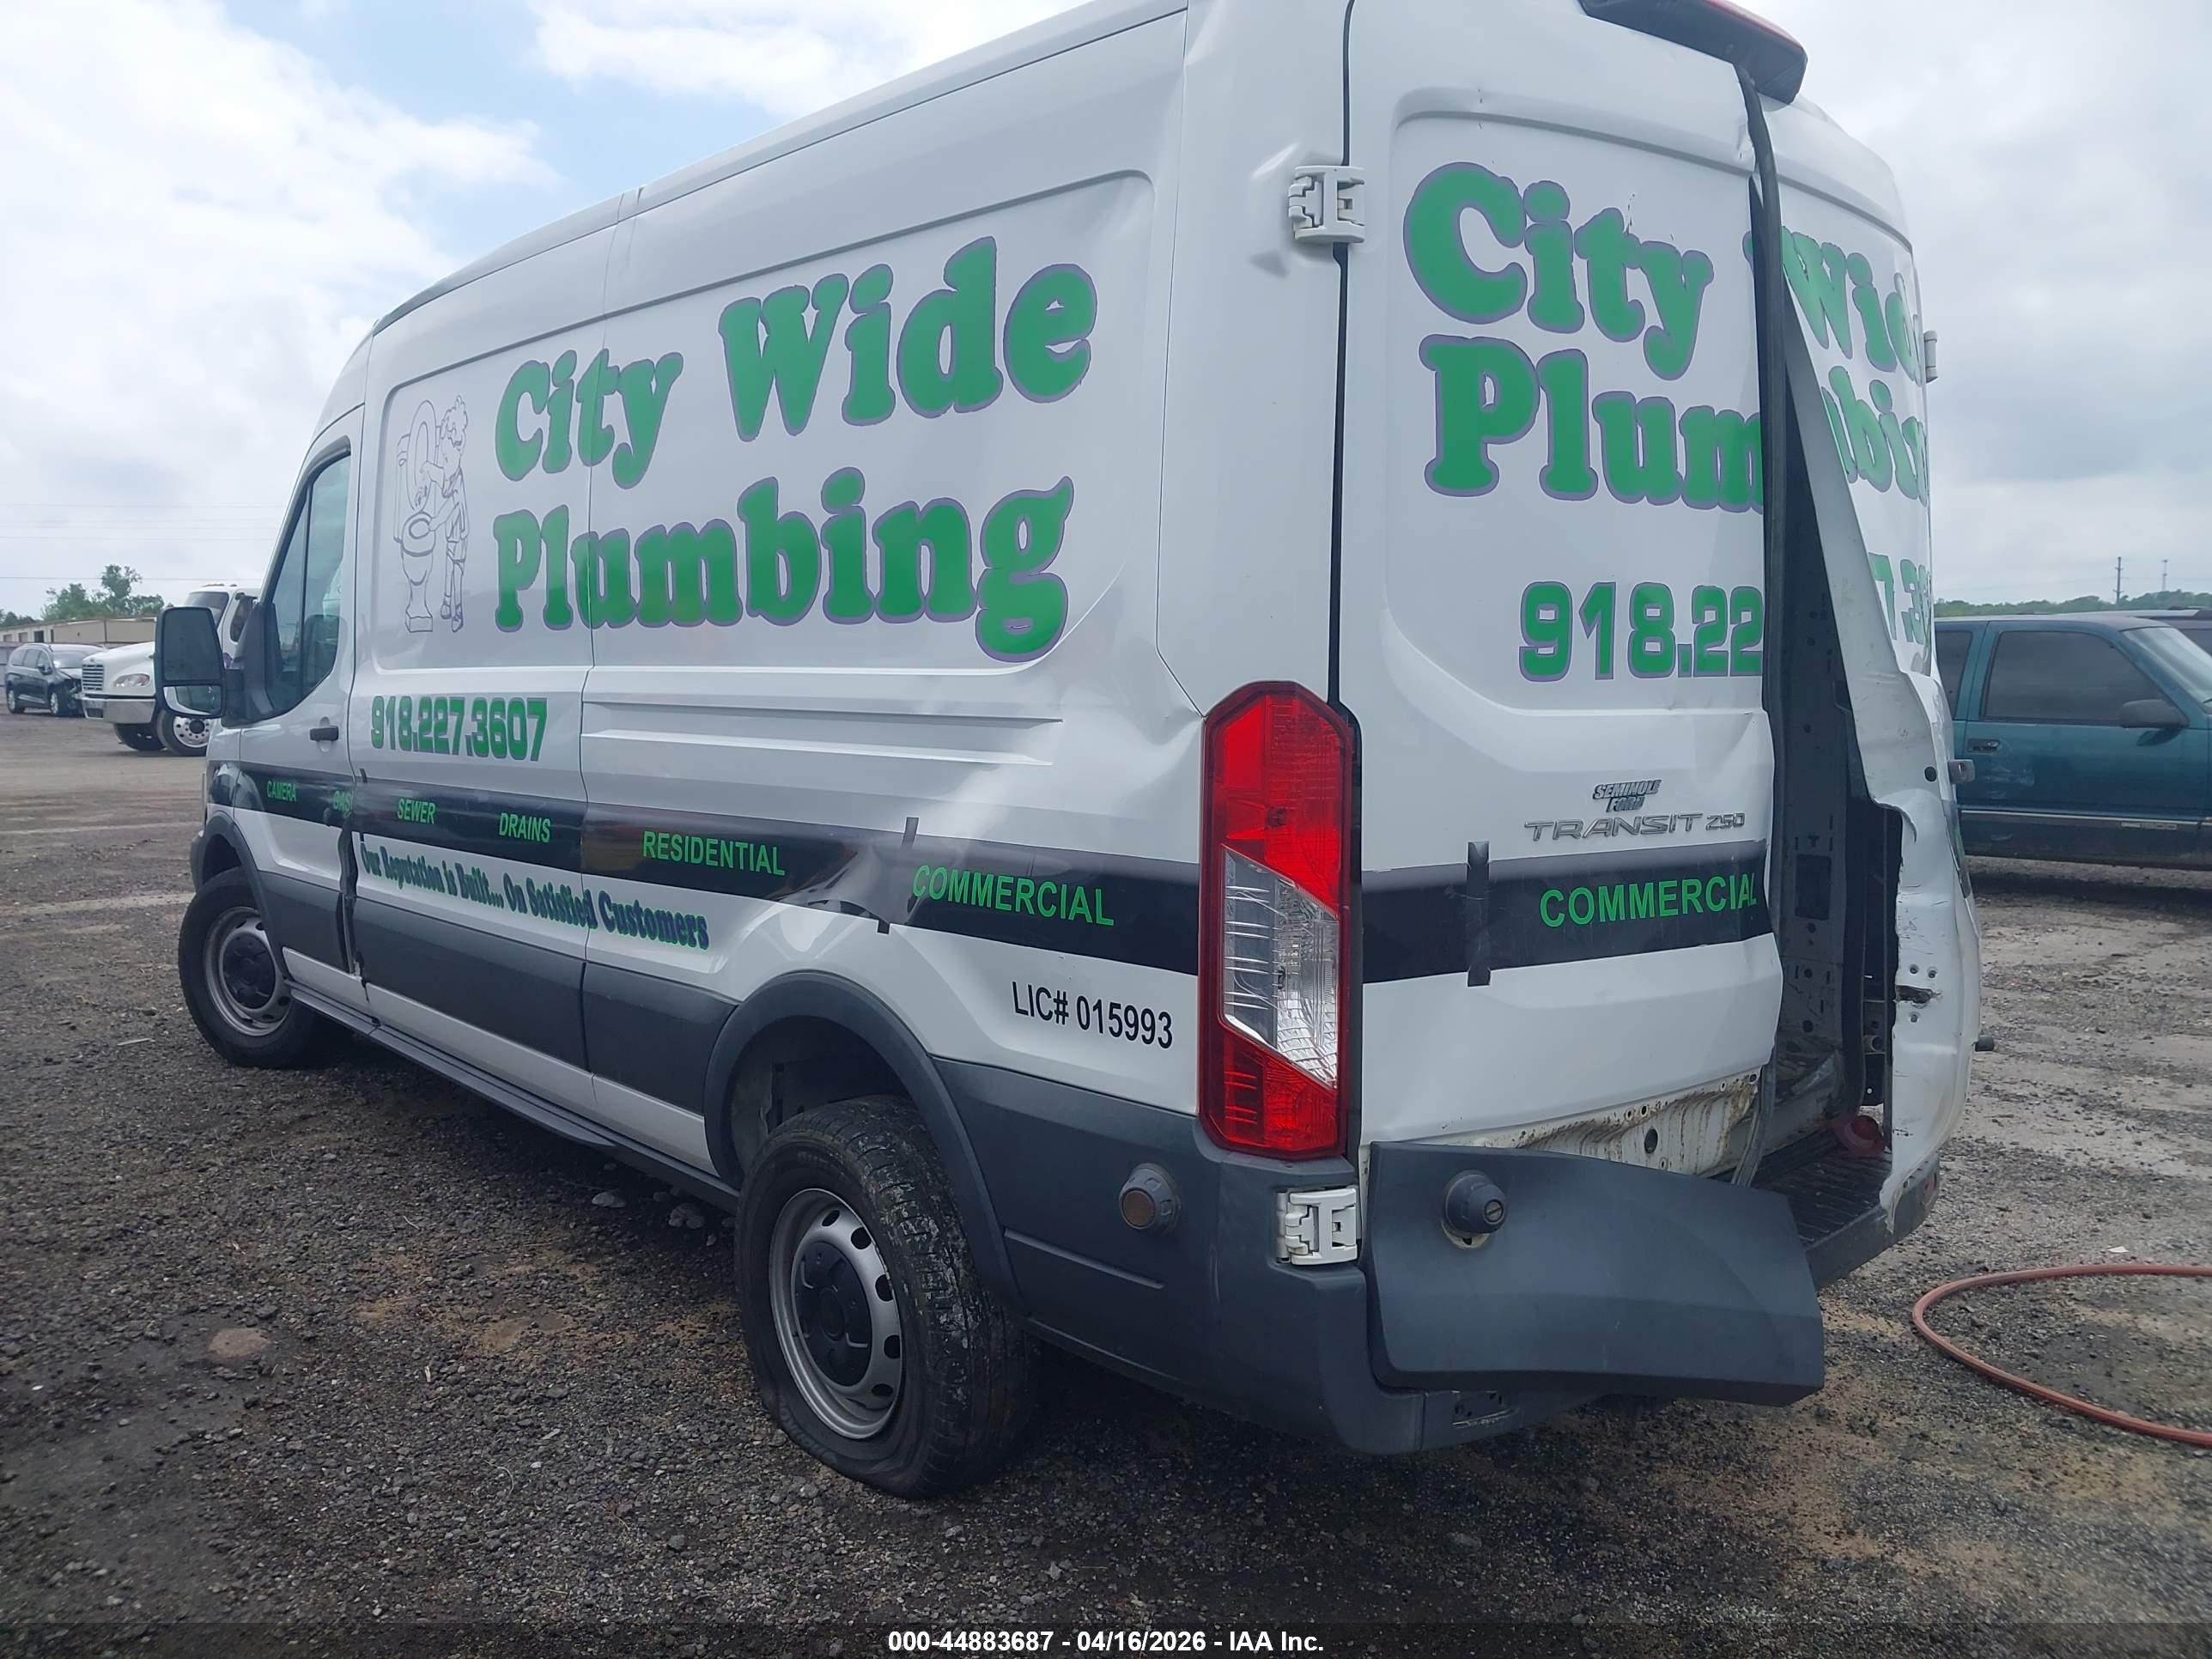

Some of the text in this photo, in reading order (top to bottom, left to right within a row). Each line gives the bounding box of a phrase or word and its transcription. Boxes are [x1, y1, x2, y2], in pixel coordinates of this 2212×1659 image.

[1403, 161, 1924, 387] City Wid
[494, 235, 1097, 489] City Wide
[493, 466, 1074, 664] Plumbing
[371, 695, 548, 762] 918.227.3607
[266, 780, 296, 803] CAMERA
[397, 798, 437, 824] SEWER
[1593, 779, 1662, 799] SEMINOLE
[498, 812, 551, 843] DRAINS
[643, 830, 786, 876] RESIDENTIAL
[1524, 812, 1746, 842] TRANSIT 250
[361, 842, 381, 877] Our
[380, 846, 445, 893] Reputation
[441, 860, 458, 896] is
[503, 872, 527, 914] On
[526, 877, 598, 929] Satisfied
[598, 890, 709, 951] Customers
[912, 865, 1115, 927] COMMERCIAL
[1540, 872, 1757, 928] COMMERCIAL
[1012, 981, 1173, 1049] LIC# 015993
